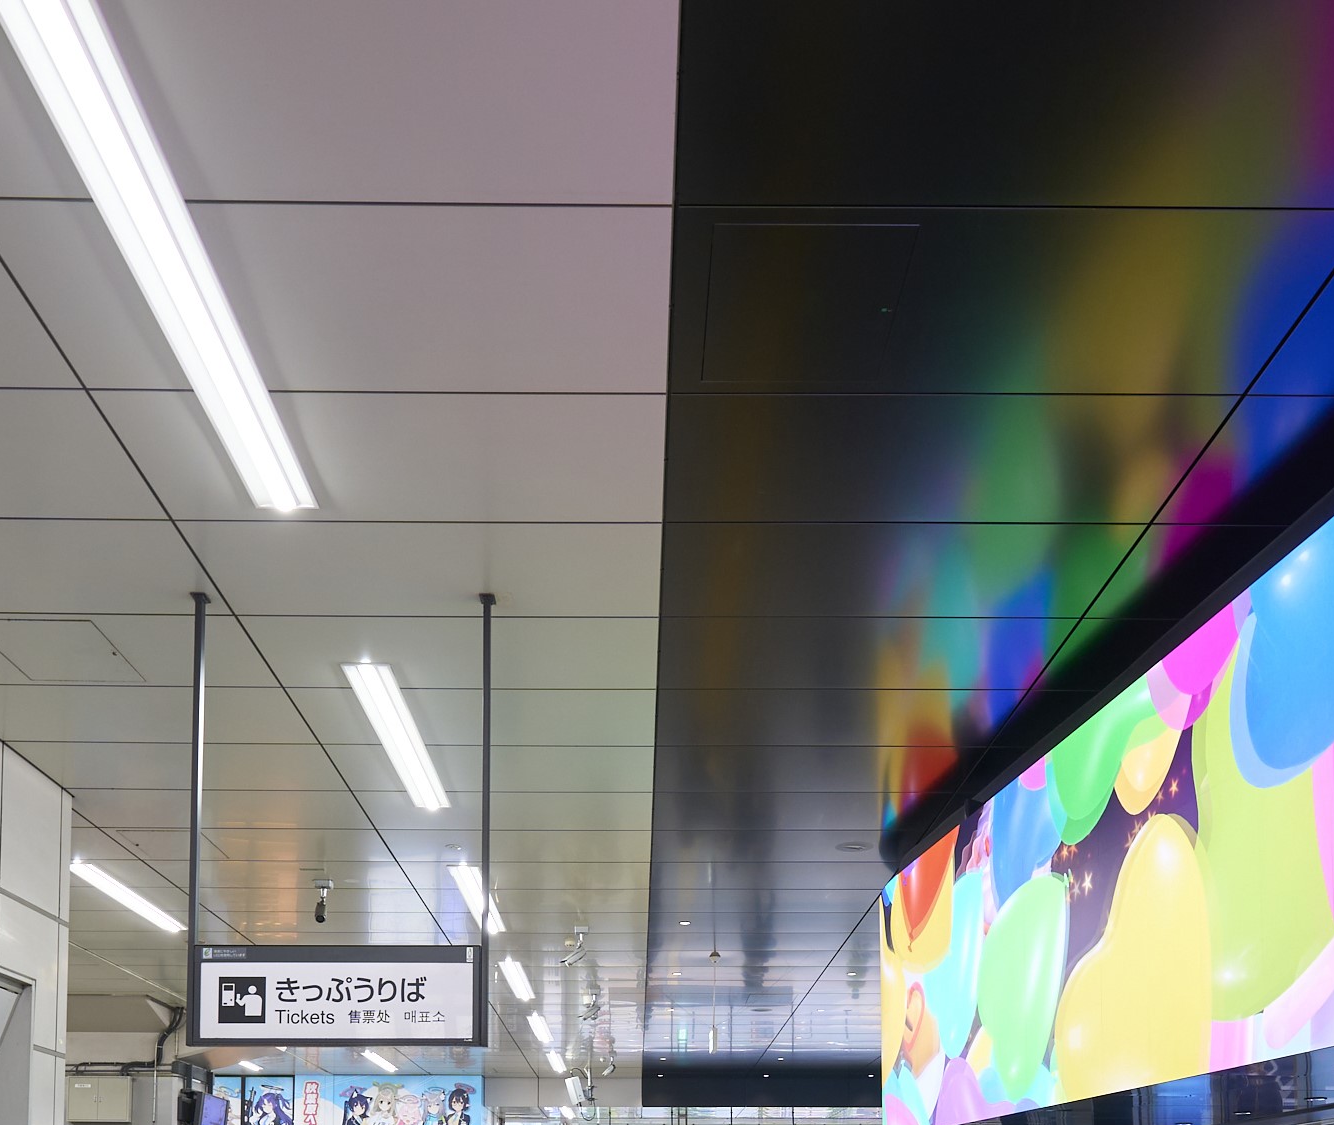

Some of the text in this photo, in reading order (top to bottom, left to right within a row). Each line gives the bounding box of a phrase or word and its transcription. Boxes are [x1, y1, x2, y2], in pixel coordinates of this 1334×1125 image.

[275, 977, 427, 1003] きっぷうりば
[275, 1009, 446, 1024] Tickets 售票处 매표소
